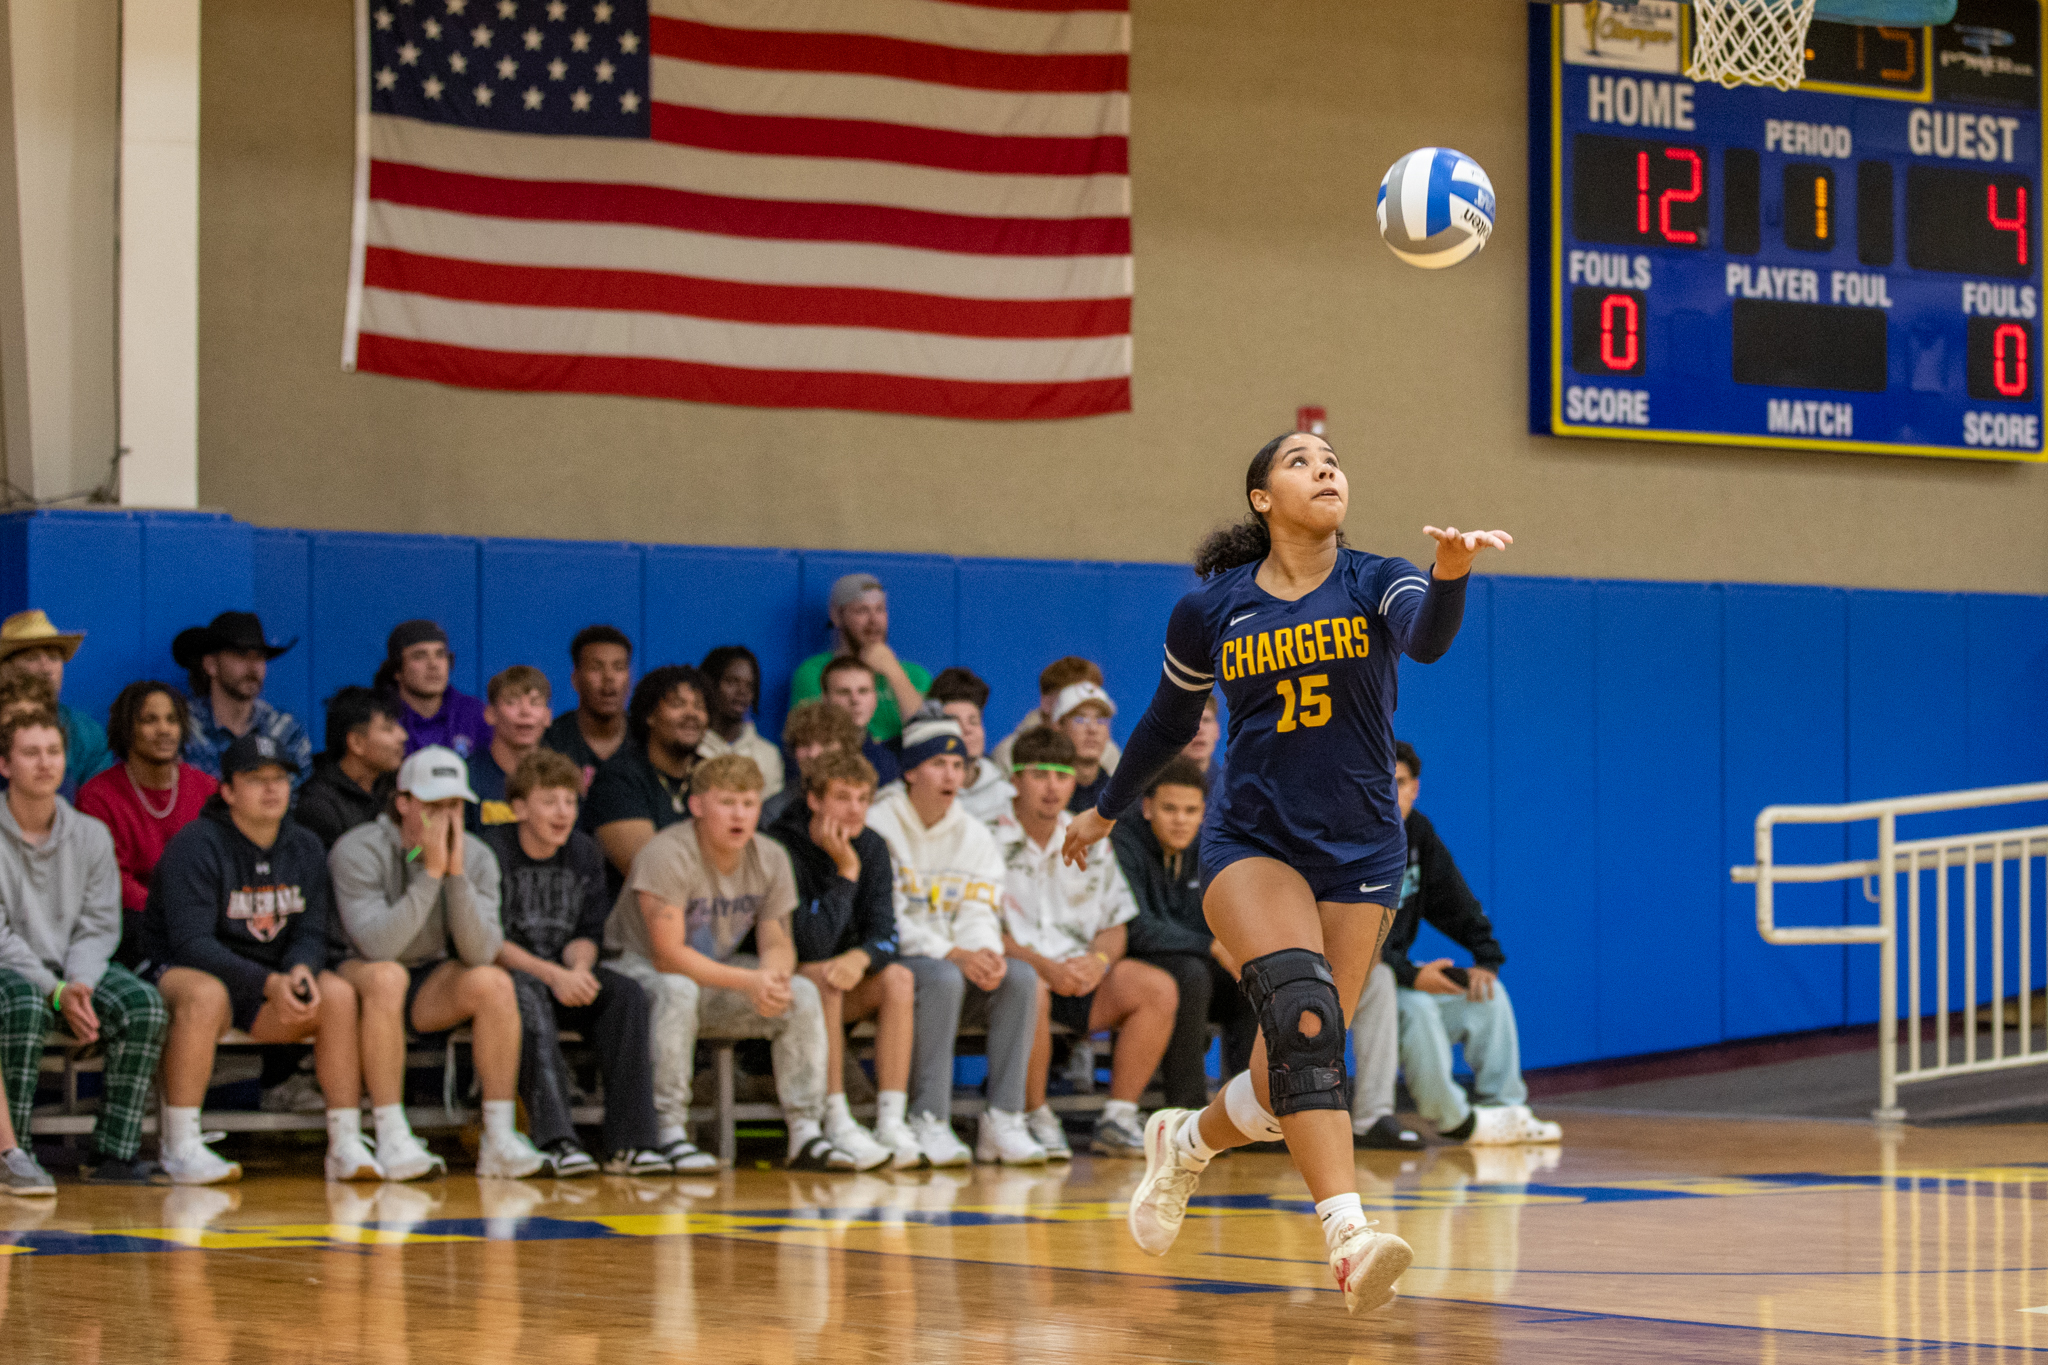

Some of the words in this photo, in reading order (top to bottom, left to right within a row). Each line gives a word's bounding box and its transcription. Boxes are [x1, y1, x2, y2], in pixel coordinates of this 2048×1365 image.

[1588, 74, 1696, 131] HOME
[1765, 119, 1852, 159] PERIOD
[1908, 108, 2019, 163] GUEST
[1637, 147, 1702, 244] 12
[1814, 176, 1828, 240] 1
[1987, 184, 2028, 266] 4
[1568, 250, 1652, 290] FOULS
[1725, 262, 1819, 303] PLAYER
[1831, 271, 1893, 308] FOUL
[1961, 281, 2037, 318] FOULS
[1600, 293, 1639, 370] 0
[1992, 323, 2028, 397] 0
[1566, 385, 1650, 426] SCORE
[1767, 399, 1853, 437] MATCH
[1963, 411, 2039, 448] SCORE
[1222, 616, 1369, 681] CHARGERS
[1276, 673, 1332, 733] 15
